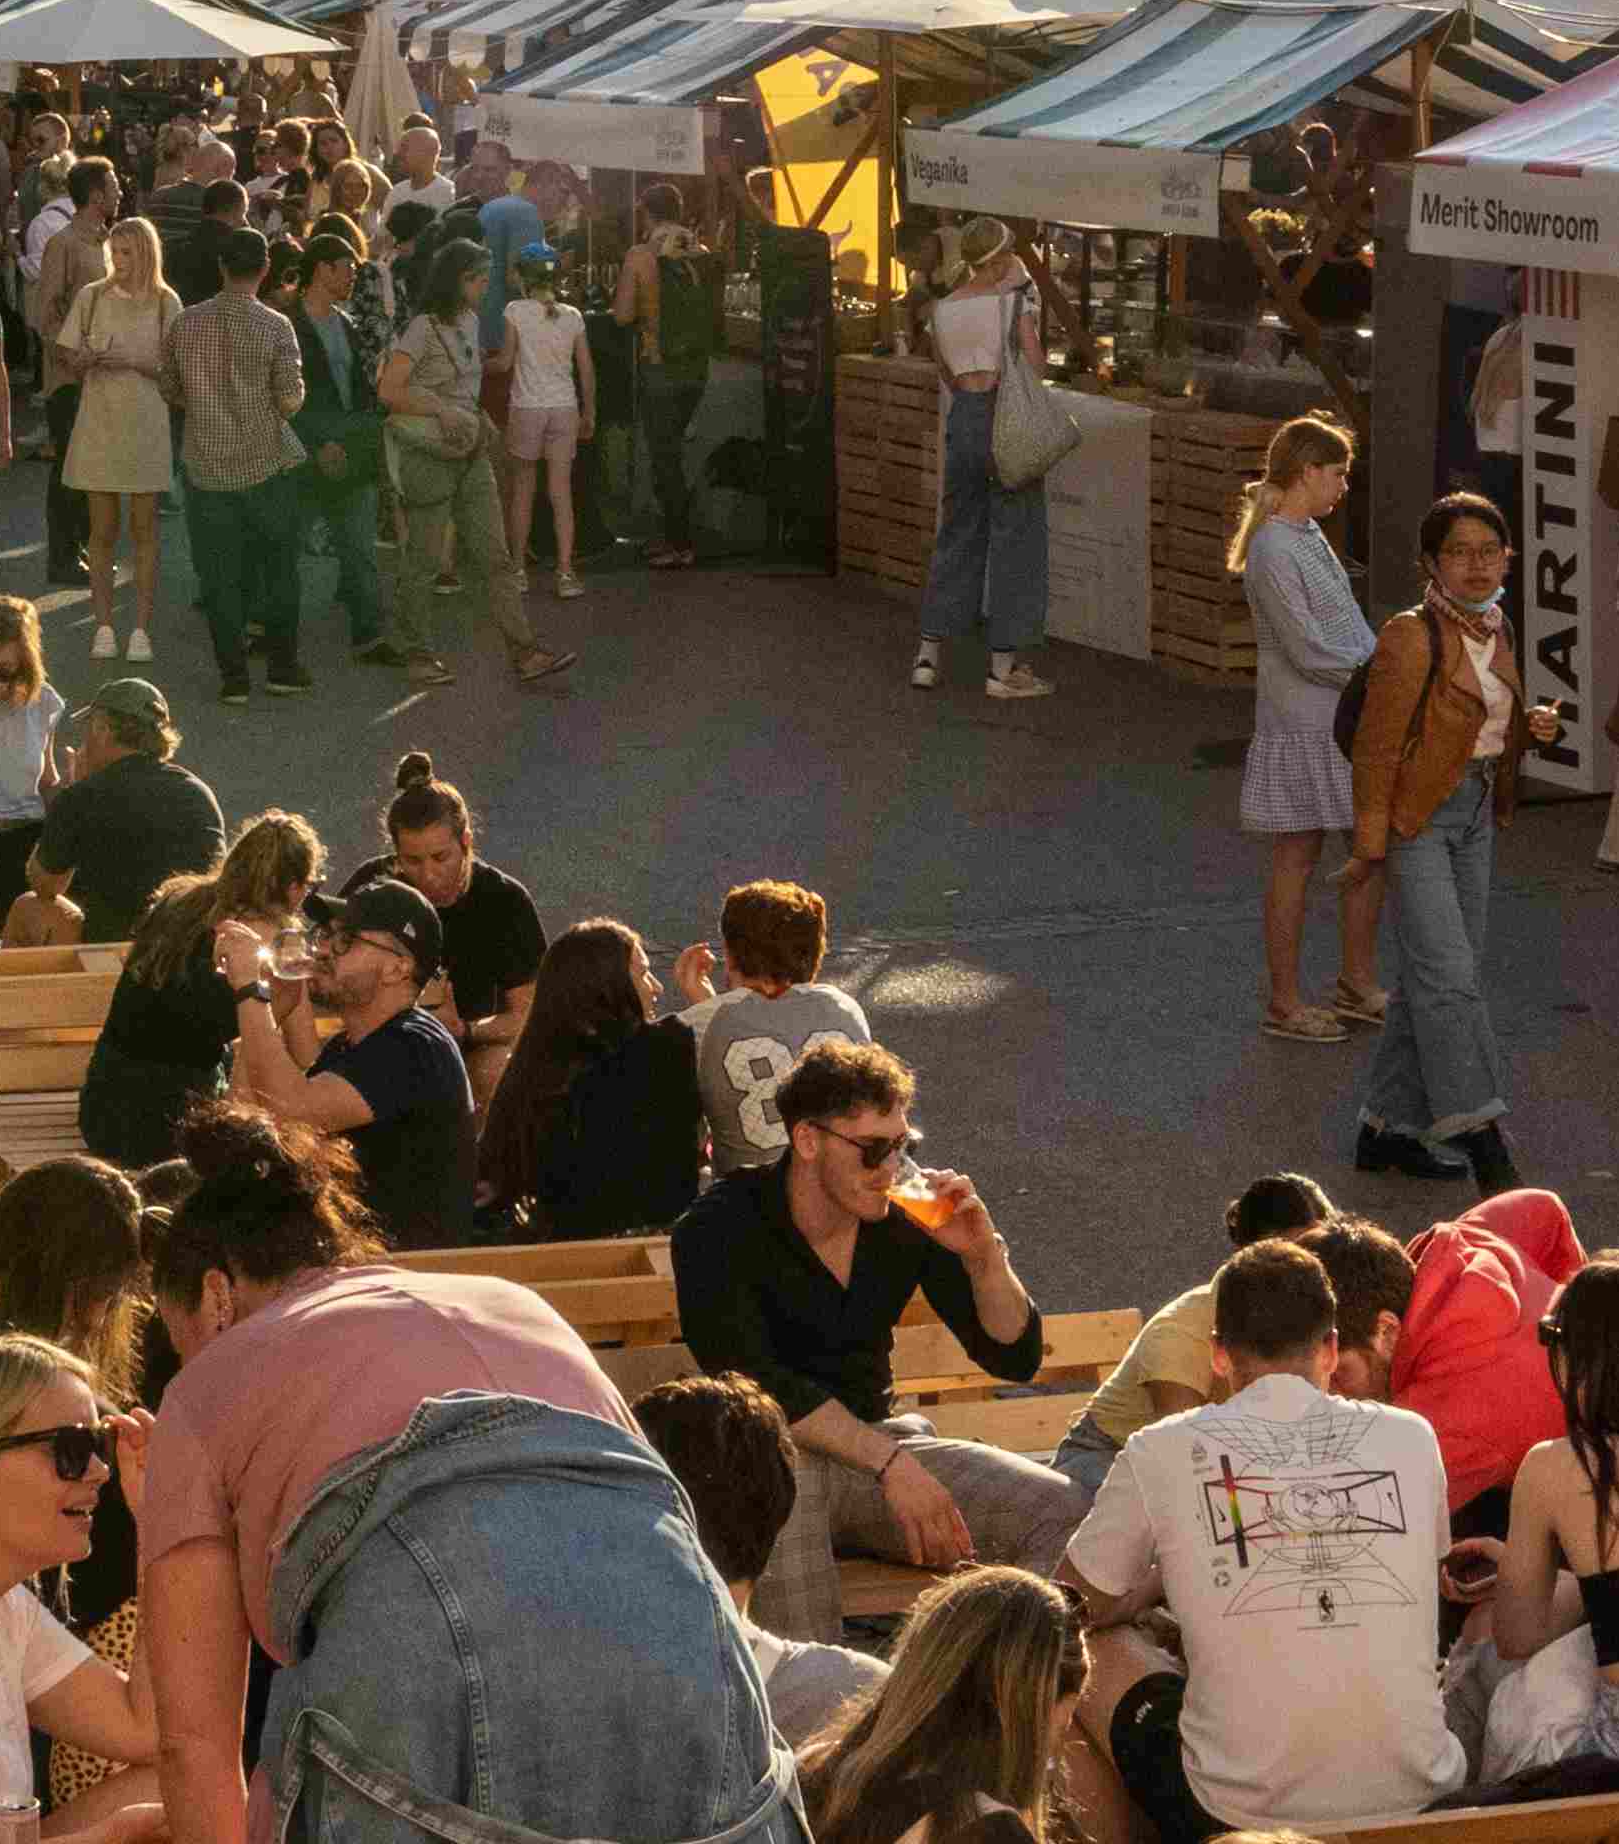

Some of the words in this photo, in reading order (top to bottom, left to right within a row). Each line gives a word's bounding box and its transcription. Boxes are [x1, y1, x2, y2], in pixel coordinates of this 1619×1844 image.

[1421, 192, 1479, 230] Merit
[1483, 199, 1600, 244] Showroom
[1533, 341, 1581, 769] MARTINI
